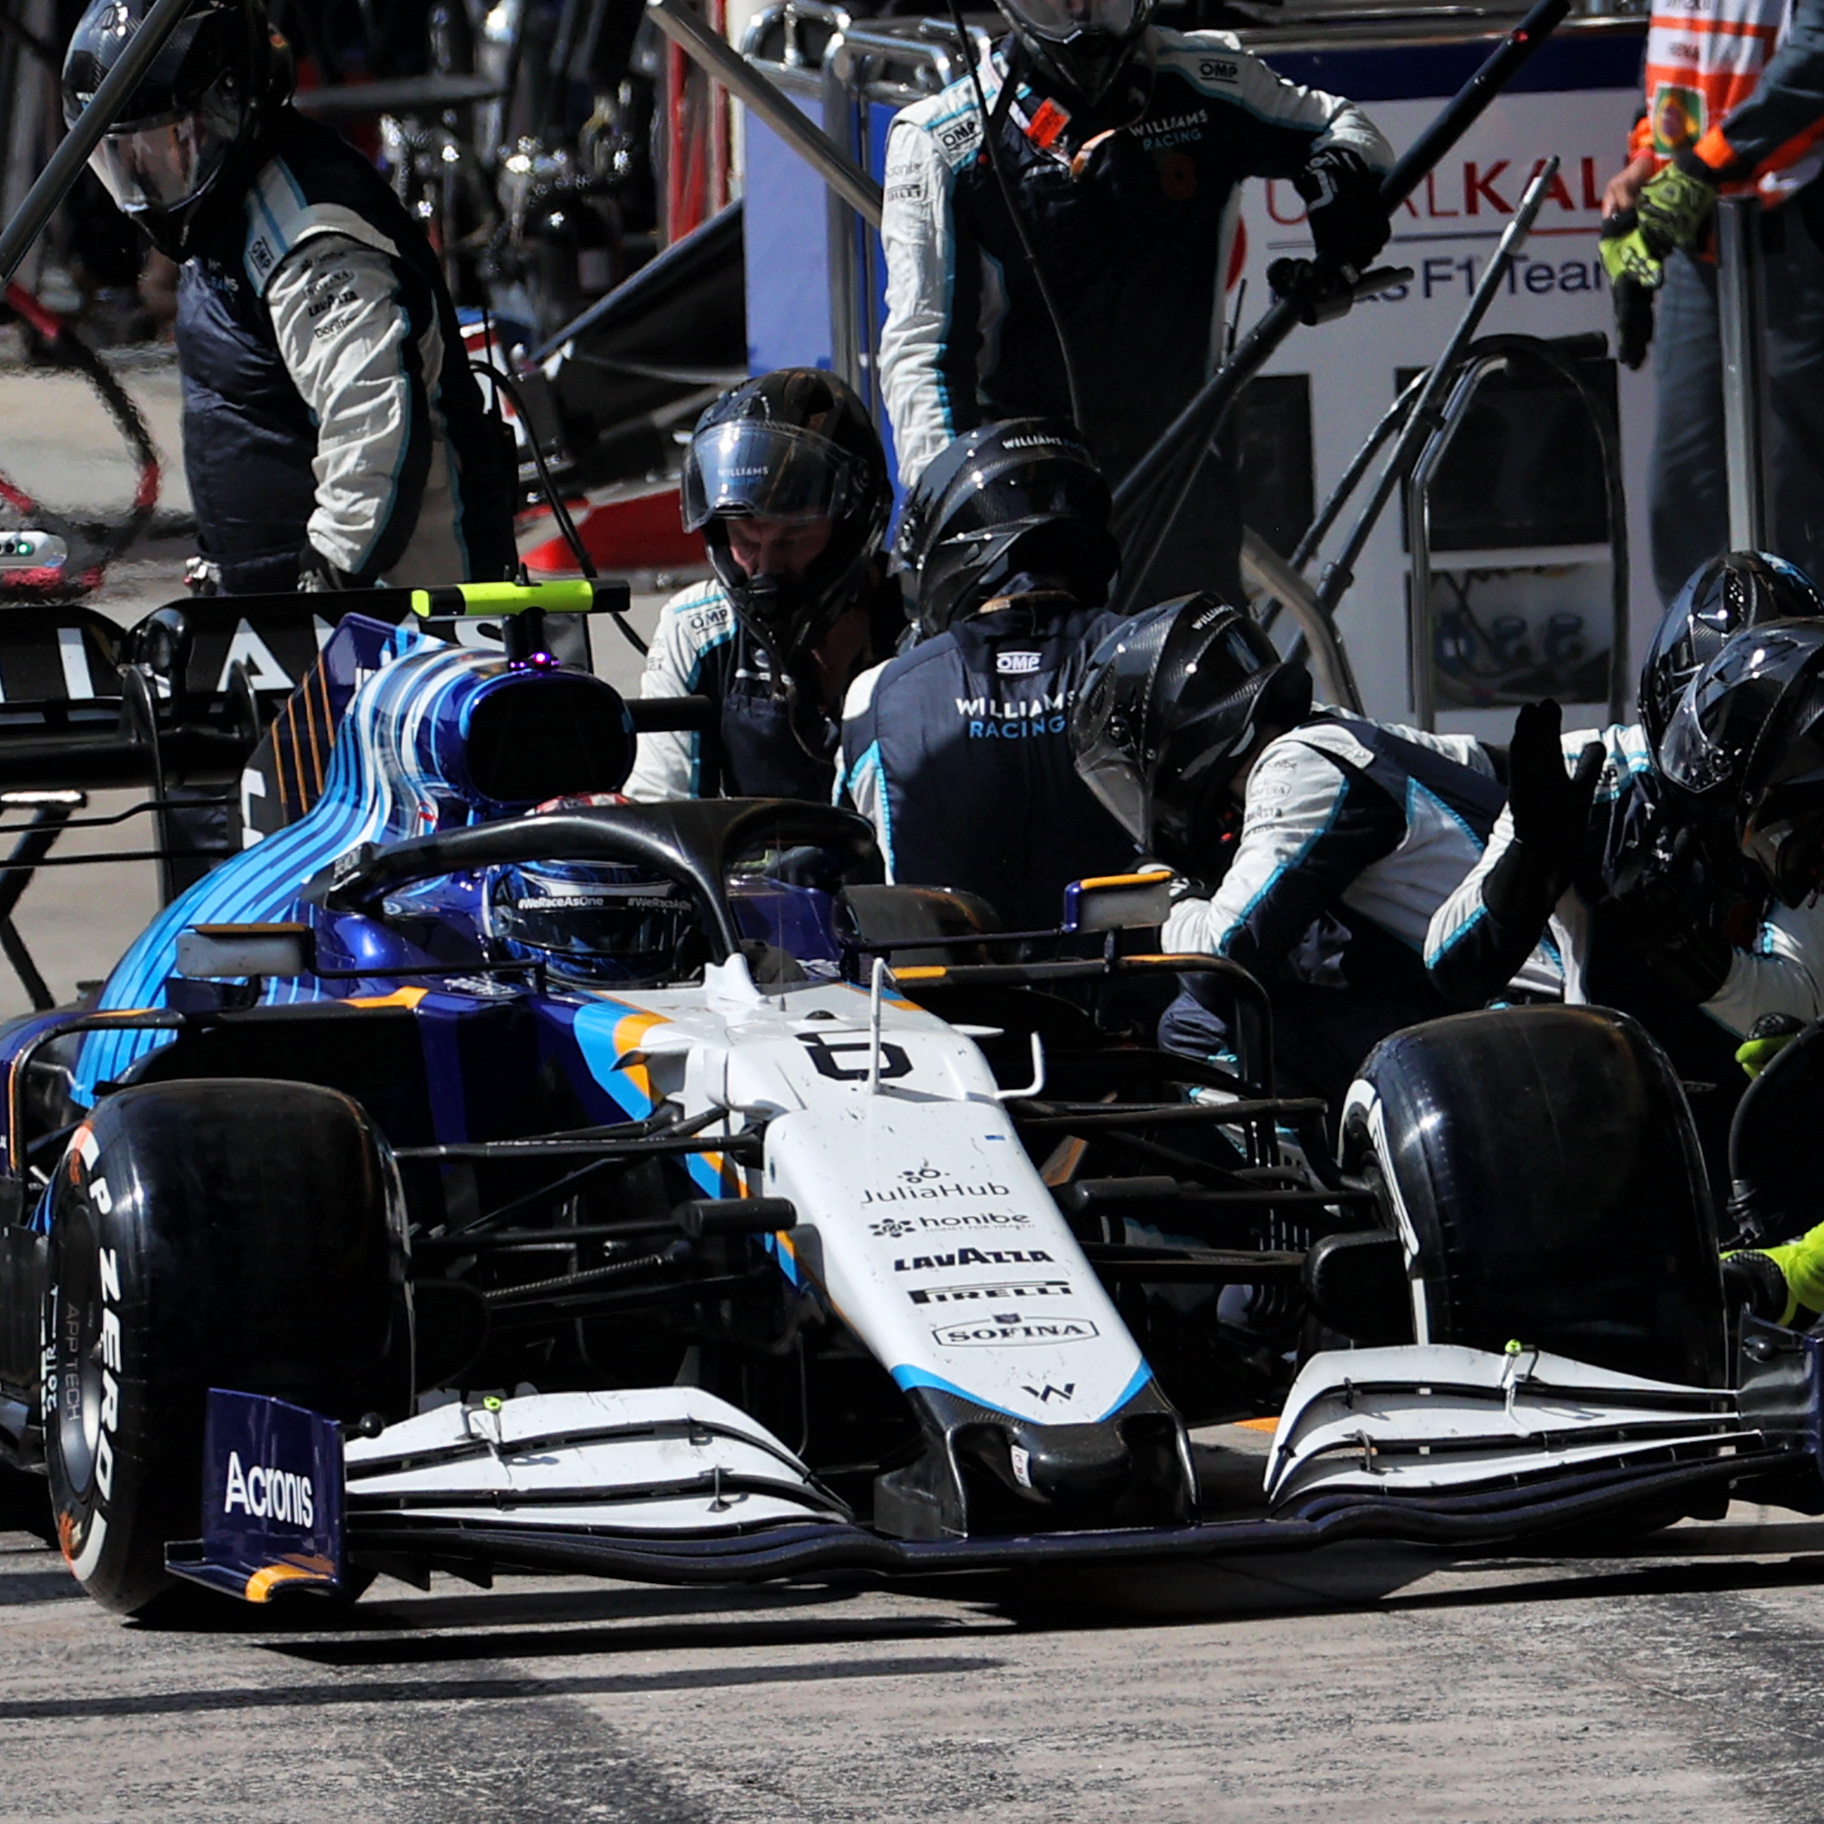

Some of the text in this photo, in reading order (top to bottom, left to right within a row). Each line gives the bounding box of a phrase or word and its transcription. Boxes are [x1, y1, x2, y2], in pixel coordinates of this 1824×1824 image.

[1199, 62, 1239, 80] OMP
[1129, 108, 1210, 139] WILLIAMS
[1142, 127, 1203, 153] RACING
[1002, 435, 1062, 450] WILLIAMS
[690, 609, 729, 631] OMP
[996, 654, 1040, 671] OMP
[955, 691, 1075, 720] WILLIAMS
[968, 715, 1066, 739] RACING
[517, 895, 605, 911] #WeRaceAsOne
[794, 1028, 914, 1082] 6
[860, 1181, 1011, 1205] JuliaHub
[919, 1212, 1032, 1227] honibe
[894, 1246, 1056, 1272] LAVAZZA
[907, 1280, 1073, 1306] PIRELLI
[88, 1177, 122, 1503] P ZERO
[947, 1324, 1088, 1343] SOFINA
[224, 1450, 315, 1530] Acronis
